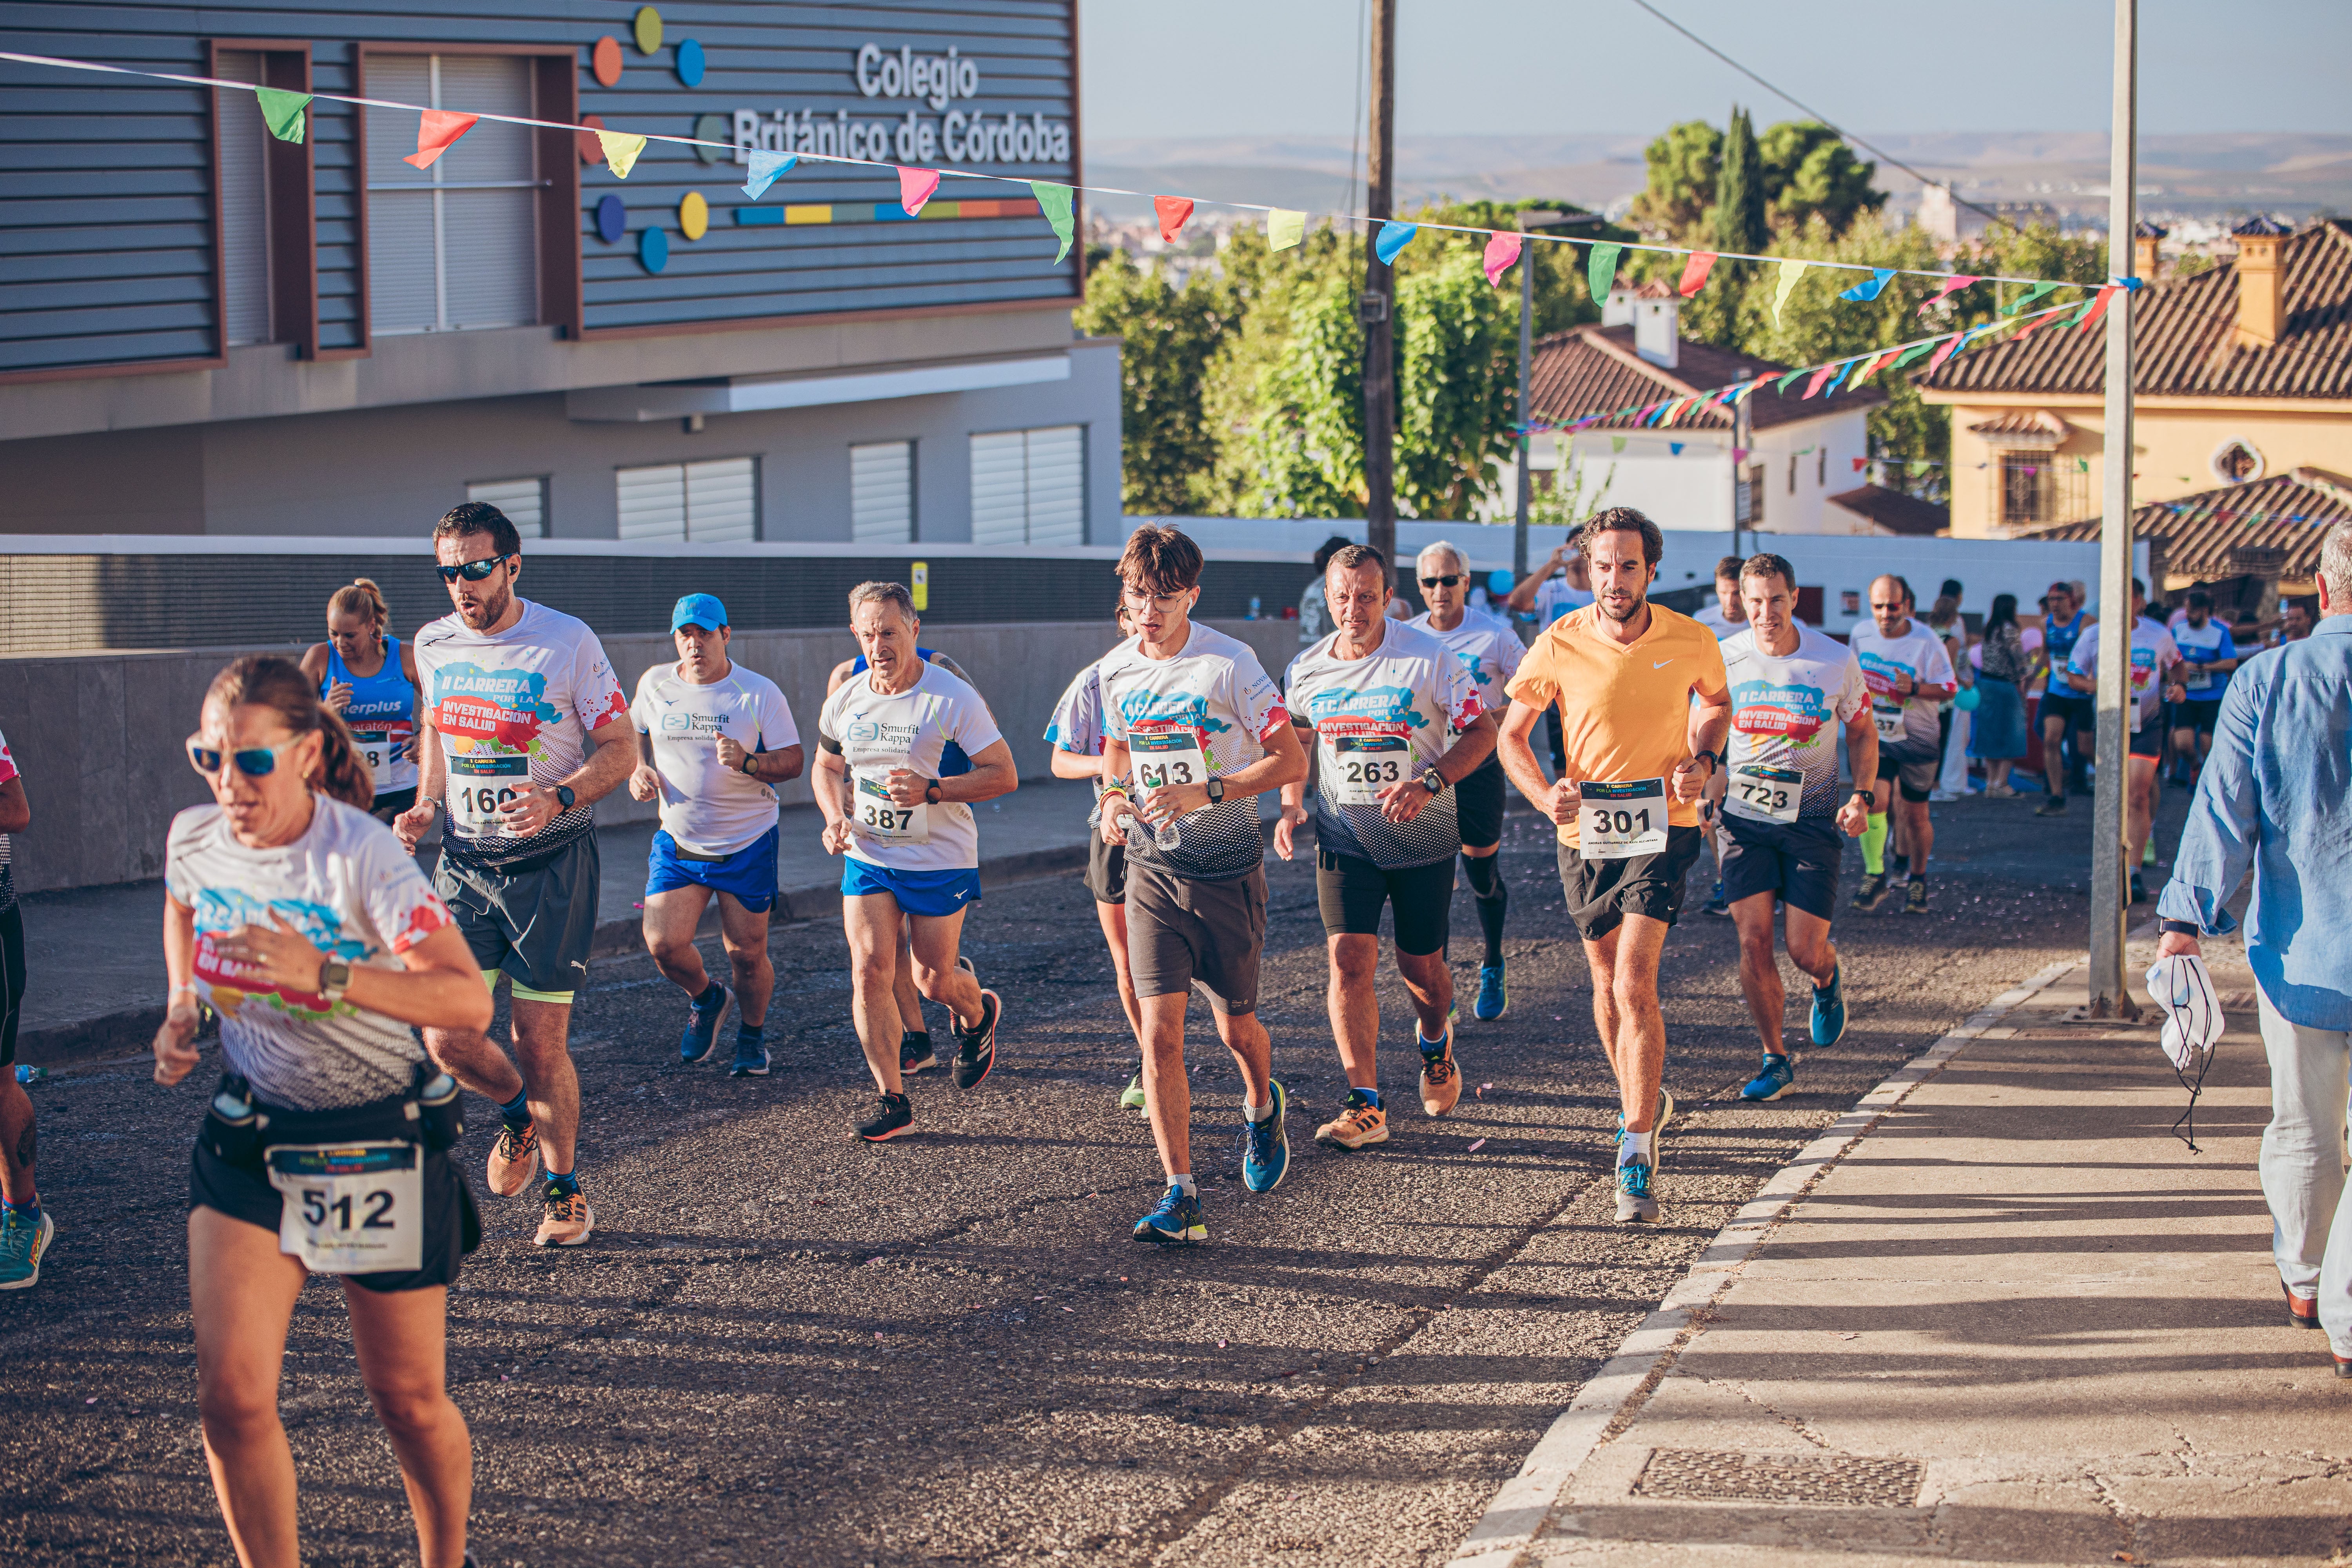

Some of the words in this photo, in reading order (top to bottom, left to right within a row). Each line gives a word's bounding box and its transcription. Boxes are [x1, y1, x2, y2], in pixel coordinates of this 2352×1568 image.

[857, 43, 978, 111] Colegio
[734, 108, 889, 164] Británico
[895, 110, 936, 162] de
[943, 109, 1070, 163] Córdoba
[442, 676, 452, 690] II
[453, 677, 531, 693] CARRERA
[1250, 684, 1270, 701] Reimagining
[1327, 694, 1401, 712] CARRERA
[1739, 691, 1747, 702] II
[1749, 691, 1814, 704] CARRERA
[443, 701, 531, 724] INVESTIGACIÓN
[1136, 701, 1197, 716] CARRERA
[1367, 709, 1388, 717] POR
[443, 713, 456, 725] EN
[459, 717, 495, 731] SALUD
[692, 713, 730, 723] Smurfit
[1739, 710, 1816, 726] INVESTIGACIÓN
[1739, 720, 1752, 728] EN
[1754, 720, 1787, 731] SALUD
[692, 722, 722, 733] Kappa
[881, 723, 920, 735] Smurfit
[1320, 722, 1404, 732] INVESTIGACIÓN
[880, 733, 911, 745] Kappa
[1141, 762, 1192, 788] 613
[1347, 761, 1399, 783] 263
[462, 787, 517, 813] 160
[1741, 783, 1788, 809] 723
[864, 805, 913, 830] 387
[1593, 808, 1650, 833] 301
[302, 1190, 396, 1230] 512
